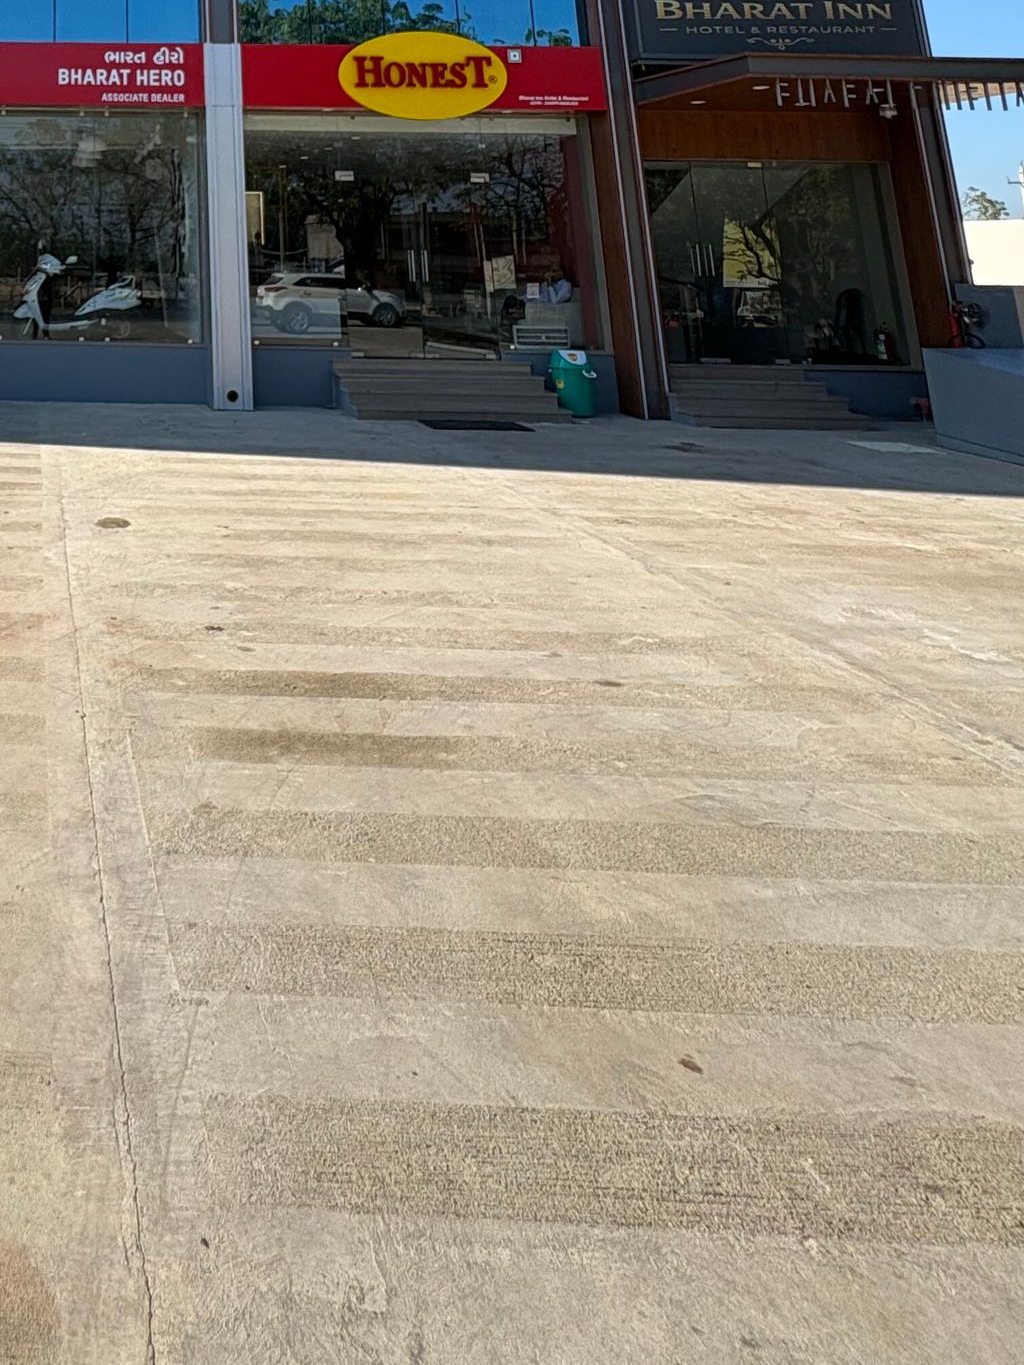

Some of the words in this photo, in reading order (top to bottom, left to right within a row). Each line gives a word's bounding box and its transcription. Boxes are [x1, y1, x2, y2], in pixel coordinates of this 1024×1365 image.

[654, 0, 813, 20] BHARAT
[823, 0, 893, 20] INN
[686, 25, 745, 34] HOTEL
[750, 25, 761, 34] &
[767, 25, 876, 34] RESTAURANT
[104, 51, 146, 64] ભારત
[152, 47, 184, 65] હીરો
[57, 68, 130, 85] BHARAT
[136, 69, 185, 87] HERO
[353, 55, 492, 89] HONEST
[101, 93, 149, 103] ASSOCIATE
[151, 93, 185, 103] DEALER
